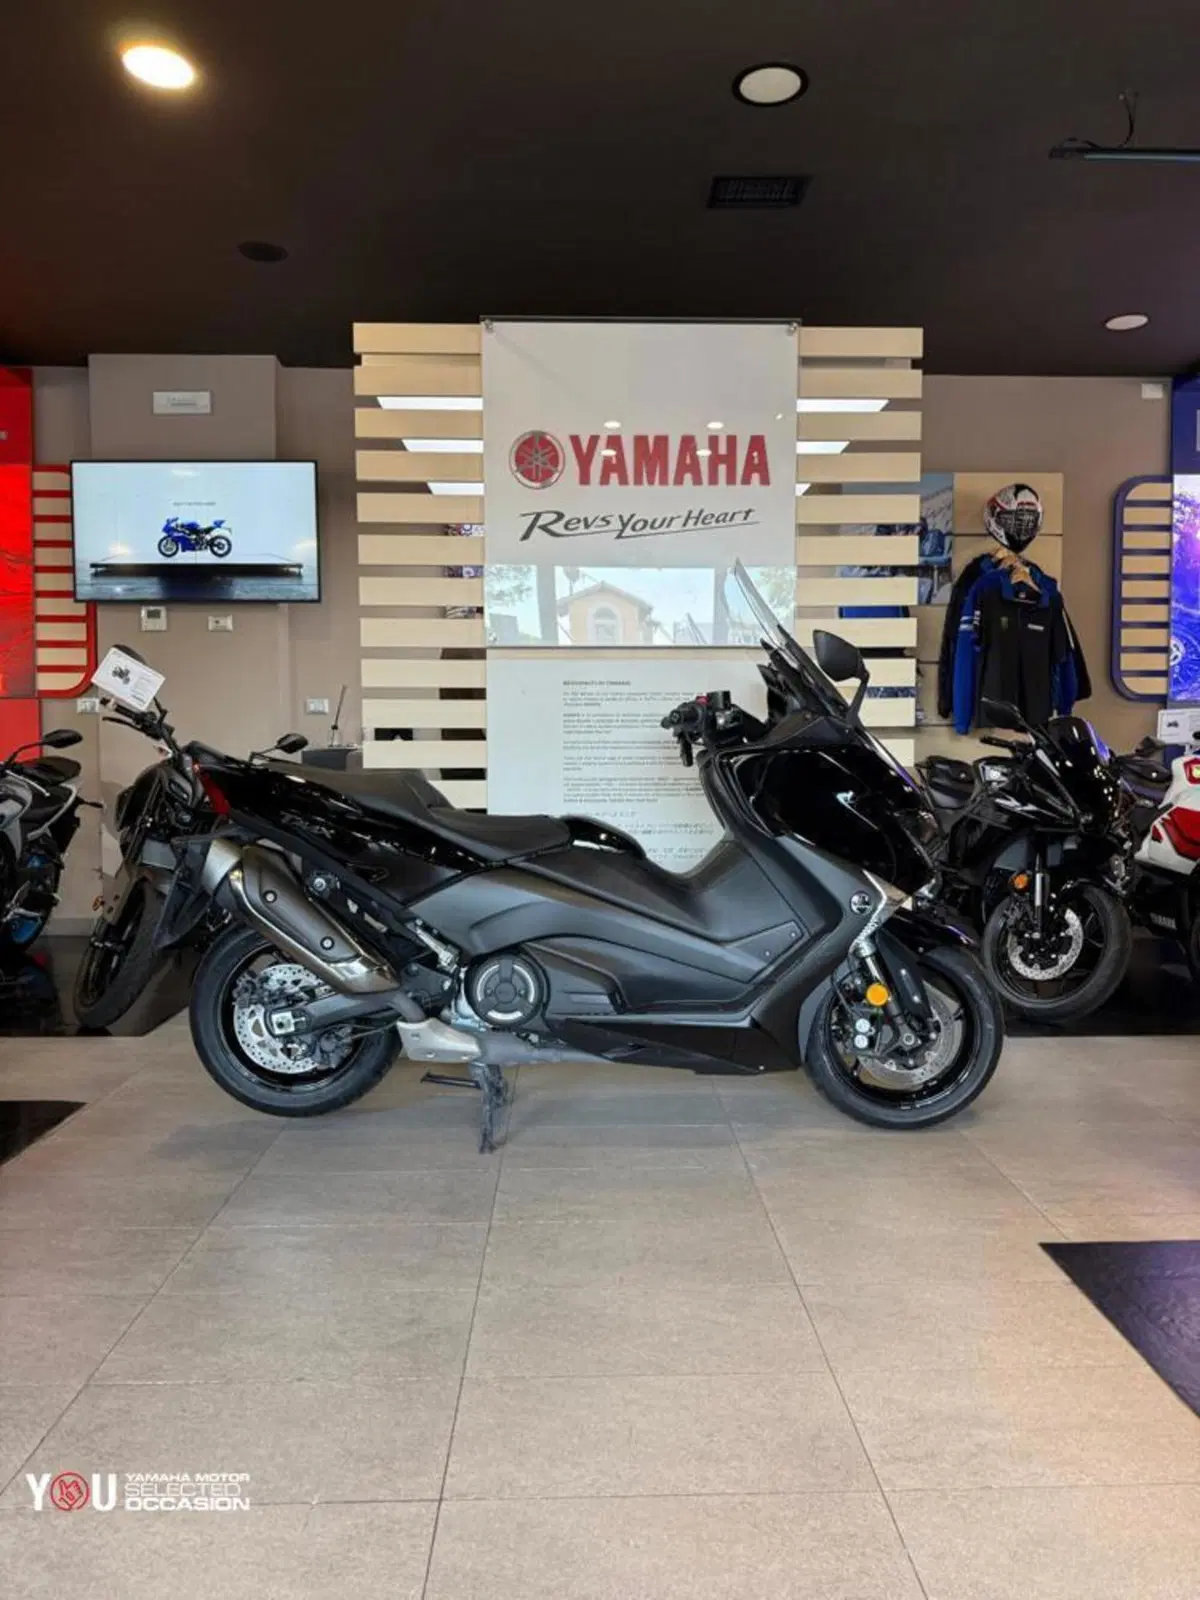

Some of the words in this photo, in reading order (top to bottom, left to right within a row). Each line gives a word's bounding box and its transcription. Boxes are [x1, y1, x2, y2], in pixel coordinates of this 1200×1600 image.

[569, 434, 771, 486] YAMAHA
[519, 510, 614, 542] Revs
[614, 511, 682, 539] Your
[681, 508, 757, 528] Heart
